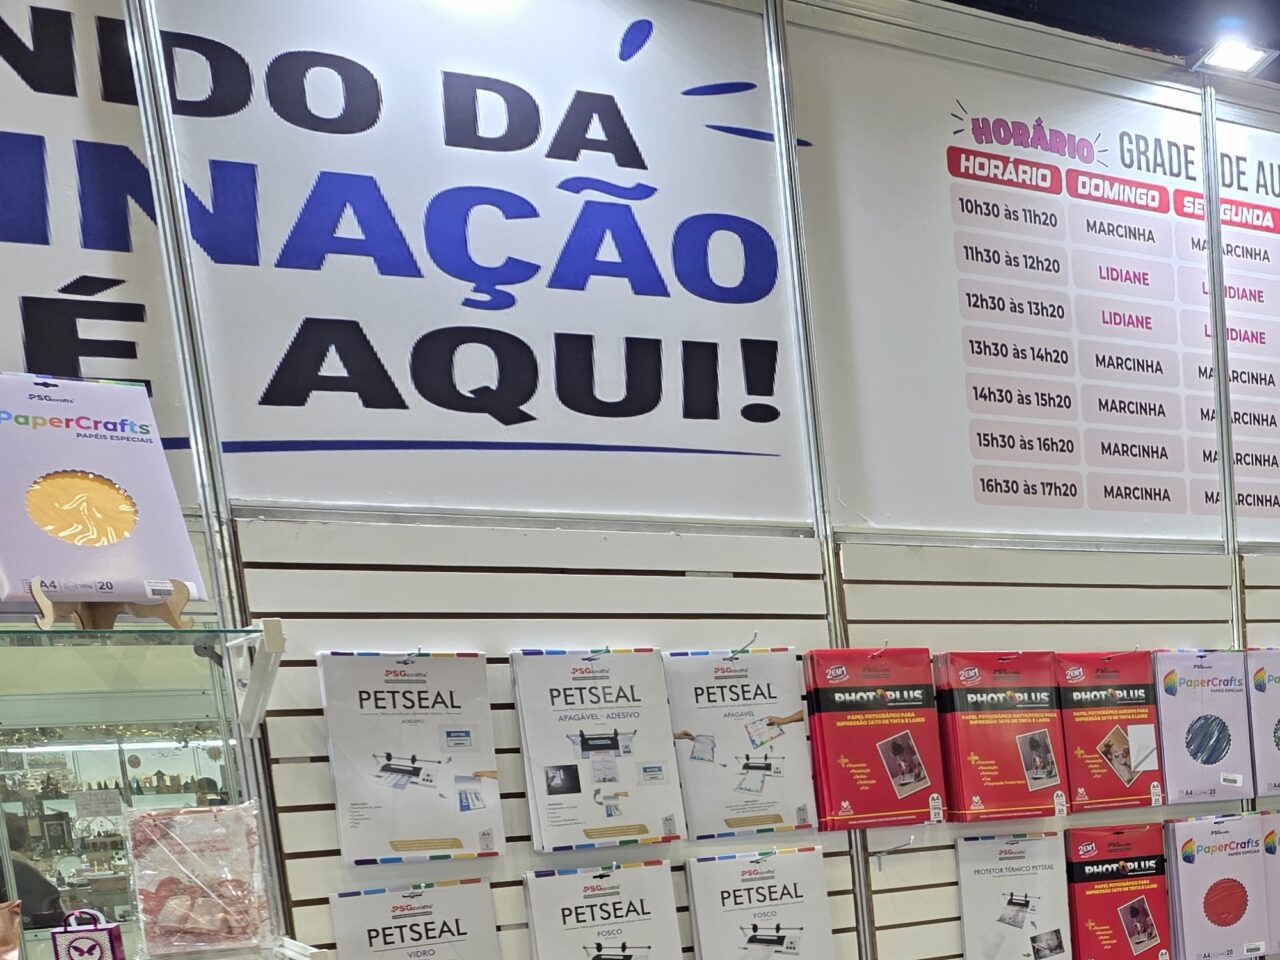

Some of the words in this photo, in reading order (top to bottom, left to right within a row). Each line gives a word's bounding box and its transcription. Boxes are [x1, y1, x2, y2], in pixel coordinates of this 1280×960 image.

[441, 70, 648, 170] DA
[971, 116, 1095, 164] HORÁRIO
[1118, 130, 1197, 182] GRADE
[1220, 152, 1249, 192] DE
[960, 156, 1051, 188] HORÁRIO
[1078, 176, 1159, 208] DOMINGO
[959, 198, 1000, 218] 10h30
[1004, 204, 1019, 222] às
[1022, 208, 1057, 228] 11h20
[1086, 219, 1155, 244] MARCINHA
[963, 246, 1000, 264] 11h30
[1005, 252, 1020, 268] às
[1023, 255, 1060, 274] 12h20
[1099, 266, 1149, 286] LIDIANE
[966, 293, 1005, 311] 12h30
[1010, 298, 1024, 314] às
[1028, 301, 1064, 319] 13h20
[1102, 310, 1152, 330] LIDIANE
[21, 275, 152, 396] É
[259, 317, 780, 425] AQUI!
[969, 340, 1008, 358] 13h30
[1012, 345, 1027, 360] às
[1030, 347, 1068, 364] 14h20
[1095, 354, 1163, 374] MARCINHA
[973, 387, 1012, 404] 14h30
[1017, 391, 1031, 405] às
[1035, 393, 1071, 409] 15h20
[1098, 398, 1166, 417] MARCINHA
[0, 411, 151, 434] PaperCrafts
[977, 433, 1015, 449] 15h30
[1019, 436, 1034, 451] às
[1037, 438, 1074, 454] 16h20
[1101, 442, 1168, 460] MARCINHA
[980, 478, 1019, 494] 16h30
[1023, 480, 1037, 495] às
[1041, 482, 1077, 497] 17h20
[1103, 485, 1171, 502] MARCINHA
[99, 581, 113, 590] 20
[694, 683, 777, 703] PETSEAL
[1179, 677, 1243, 688] PaperCrafts
[359, 690, 461, 709] PETSEAL
[549, 685, 642, 706] PETSEAL
[558, 712, 599, 722] APAGÁVEL
[606, 712, 640, 720] ADESIVO
[1197, 838, 1260, 854] PaperCrafts
[974, 868, 1003, 876] PROTETOR
[721, 883, 803, 906] PETSEAL
[561, 899, 650, 925] PETSEAL
[367, 919, 468, 947] PETSEAL
[598, 929, 622, 937] FOSCO
[408, 949, 435, 958] VIDRO
